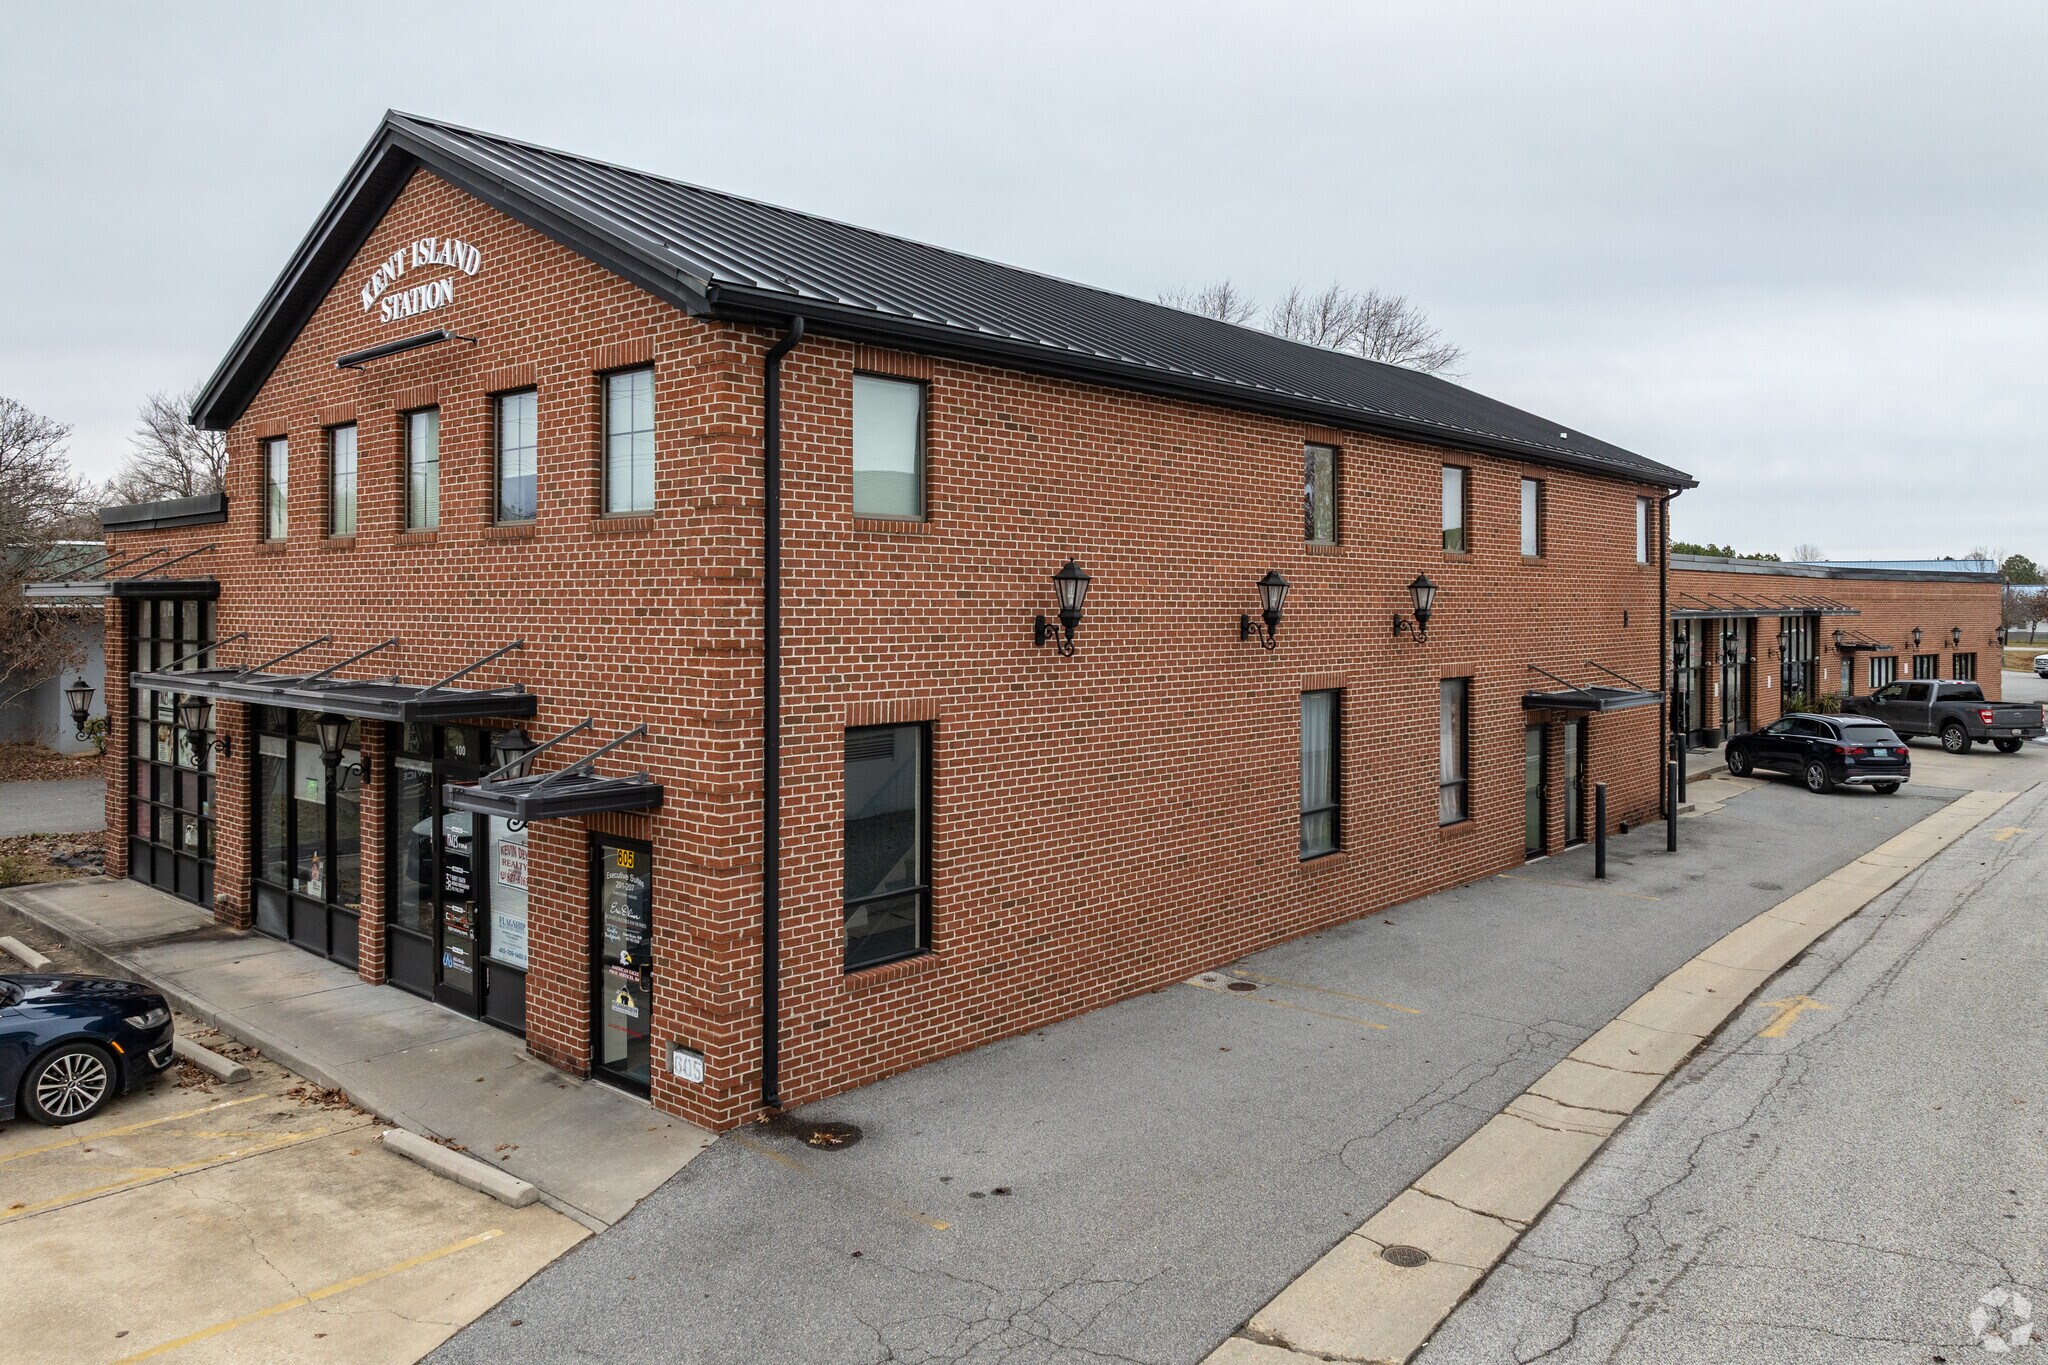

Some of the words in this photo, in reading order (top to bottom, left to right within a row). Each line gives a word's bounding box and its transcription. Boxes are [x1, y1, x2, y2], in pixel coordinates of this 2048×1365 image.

[361, 248, 406, 313] KENT
[411, 237, 481, 276] ISLAND
[381, 277, 455, 324] STATION
[455, 745, 466, 756] 100
[500, 845, 517, 857] KEVIN
[618, 850, 634, 867] 605
[501, 858, 527, 871] REALTY
[606, 871, 629, 880] Executive
[630, 874, 645, 888] Suites
[498, 915, 526, 931] FLAGSHIP
[674, 1054, 702, 1081] 605
